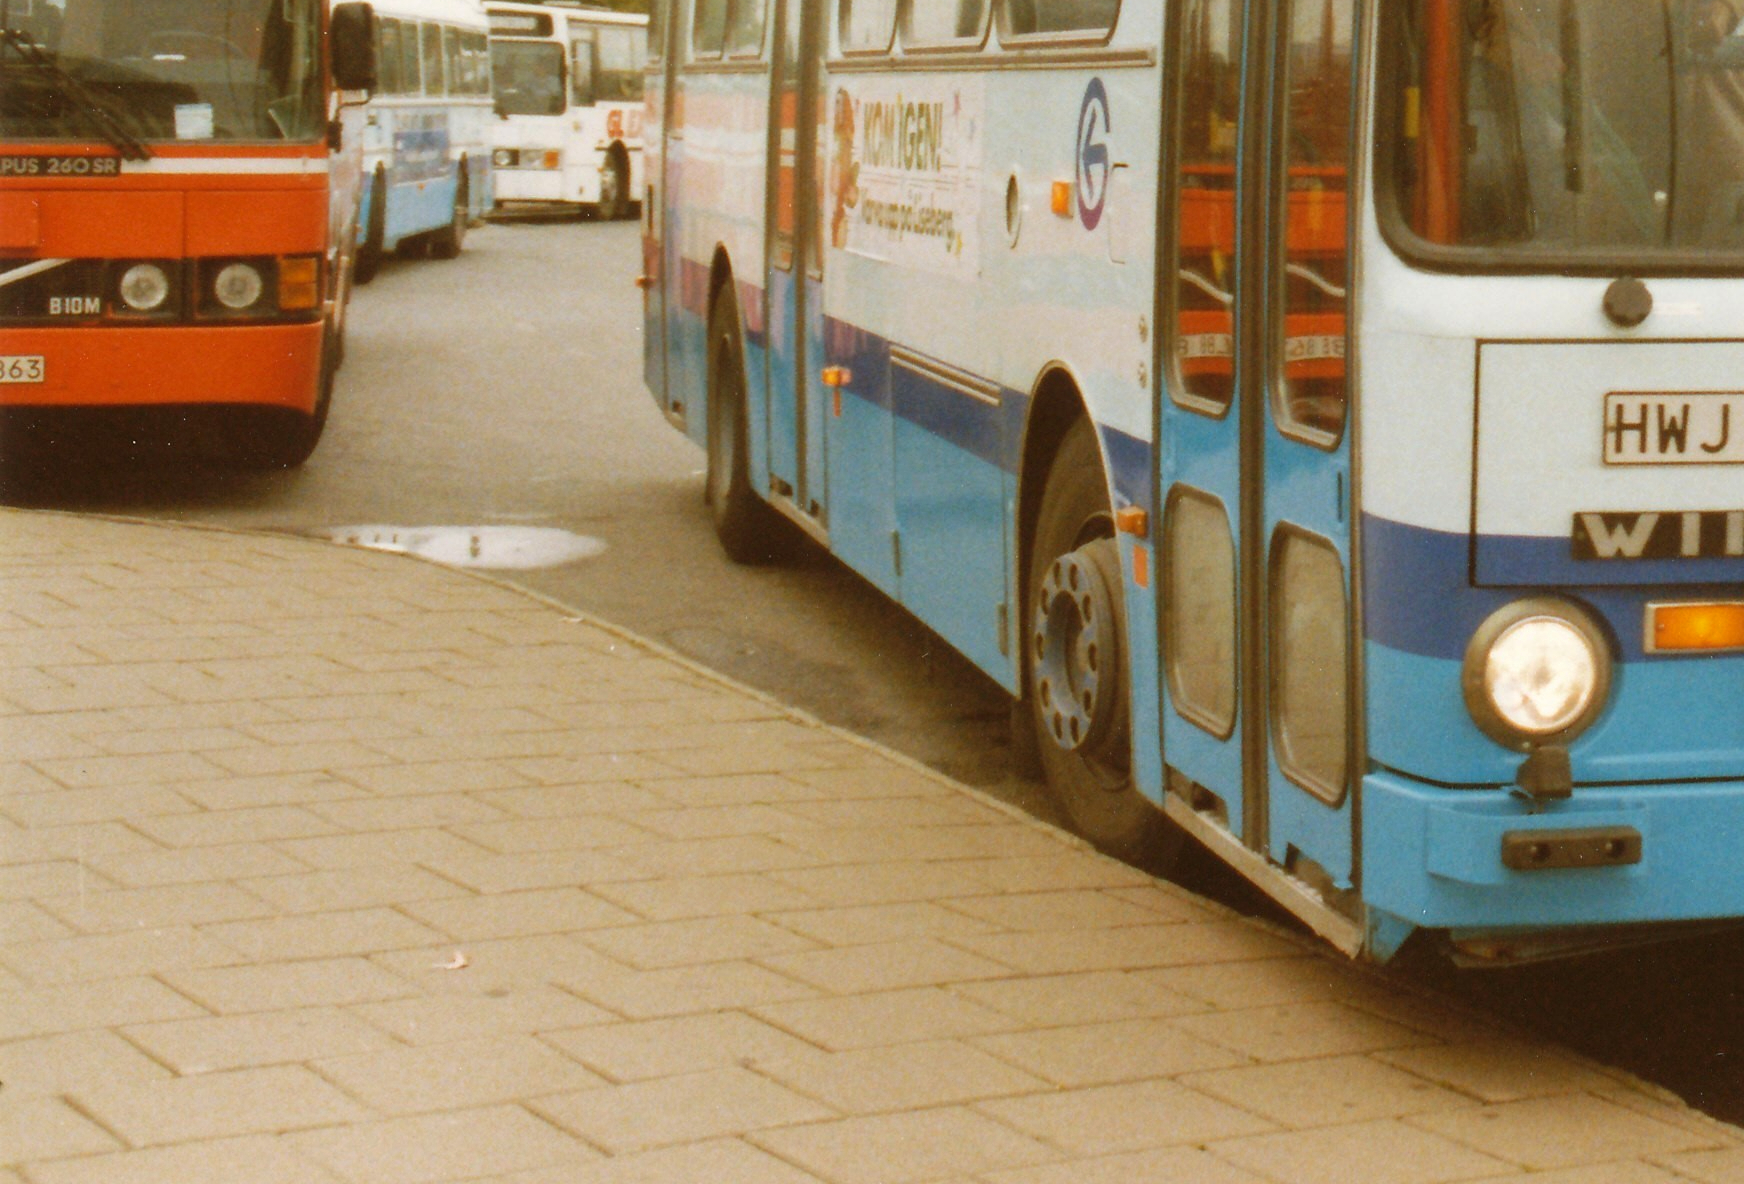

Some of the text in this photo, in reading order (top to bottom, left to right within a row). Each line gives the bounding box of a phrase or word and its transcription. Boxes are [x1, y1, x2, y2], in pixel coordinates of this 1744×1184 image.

[47, 157, 90, 174] 260
[92, 157, 117, 174] SR
[1613, 402, 1731, 454] HWJ
